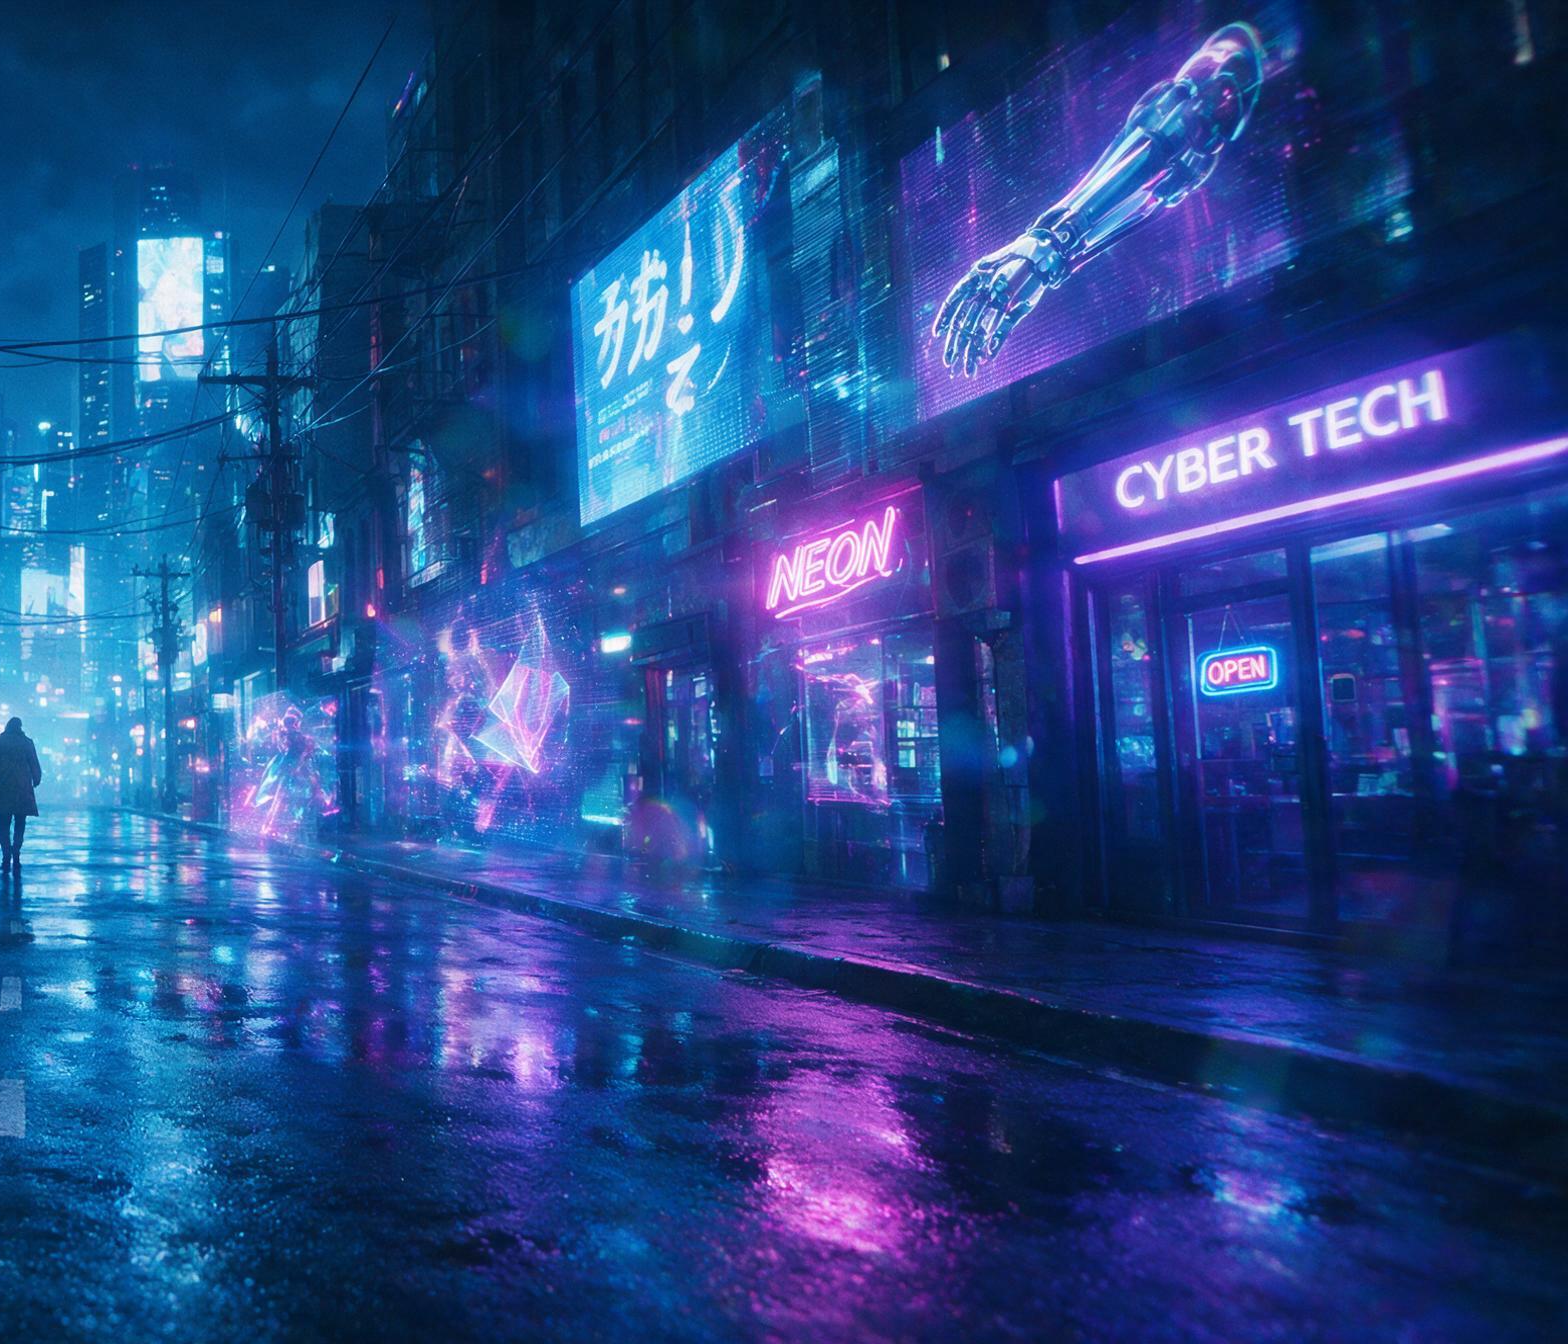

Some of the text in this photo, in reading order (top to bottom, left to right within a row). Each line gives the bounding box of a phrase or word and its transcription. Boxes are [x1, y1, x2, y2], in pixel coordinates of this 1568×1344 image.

[1115, 369, 1448, 509] CYBER TECH
[766, 506, 895, 610] NEON
[1207, 654, 1267, 685] OPEN
